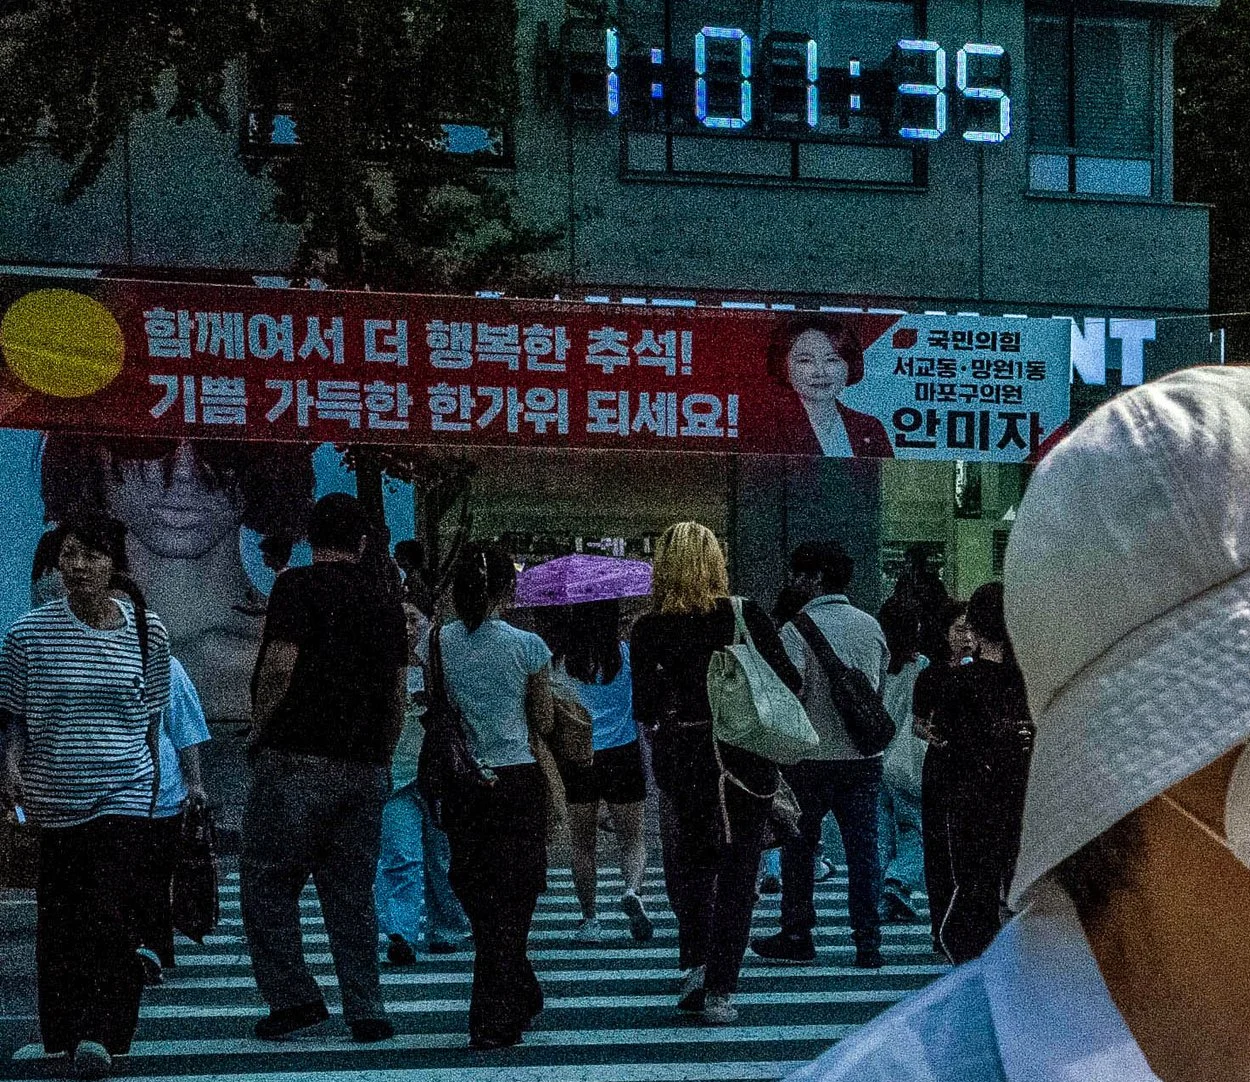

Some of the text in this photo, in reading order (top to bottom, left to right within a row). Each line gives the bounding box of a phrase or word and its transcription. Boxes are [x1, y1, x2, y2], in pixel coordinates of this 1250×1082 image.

[605, 25, 1012, 144] 1:01:35
[143, 306, 694, 377] 함께여서 더 행복한 추석!
[927, 329, 1022, 352] 국민의힘
[148, 373, 740, 440] 기쁨 가득한 한가위 되세요!
[914, 382, 1023, 405] 마포구의원
[892, 407, 1044, 453] 안미자
